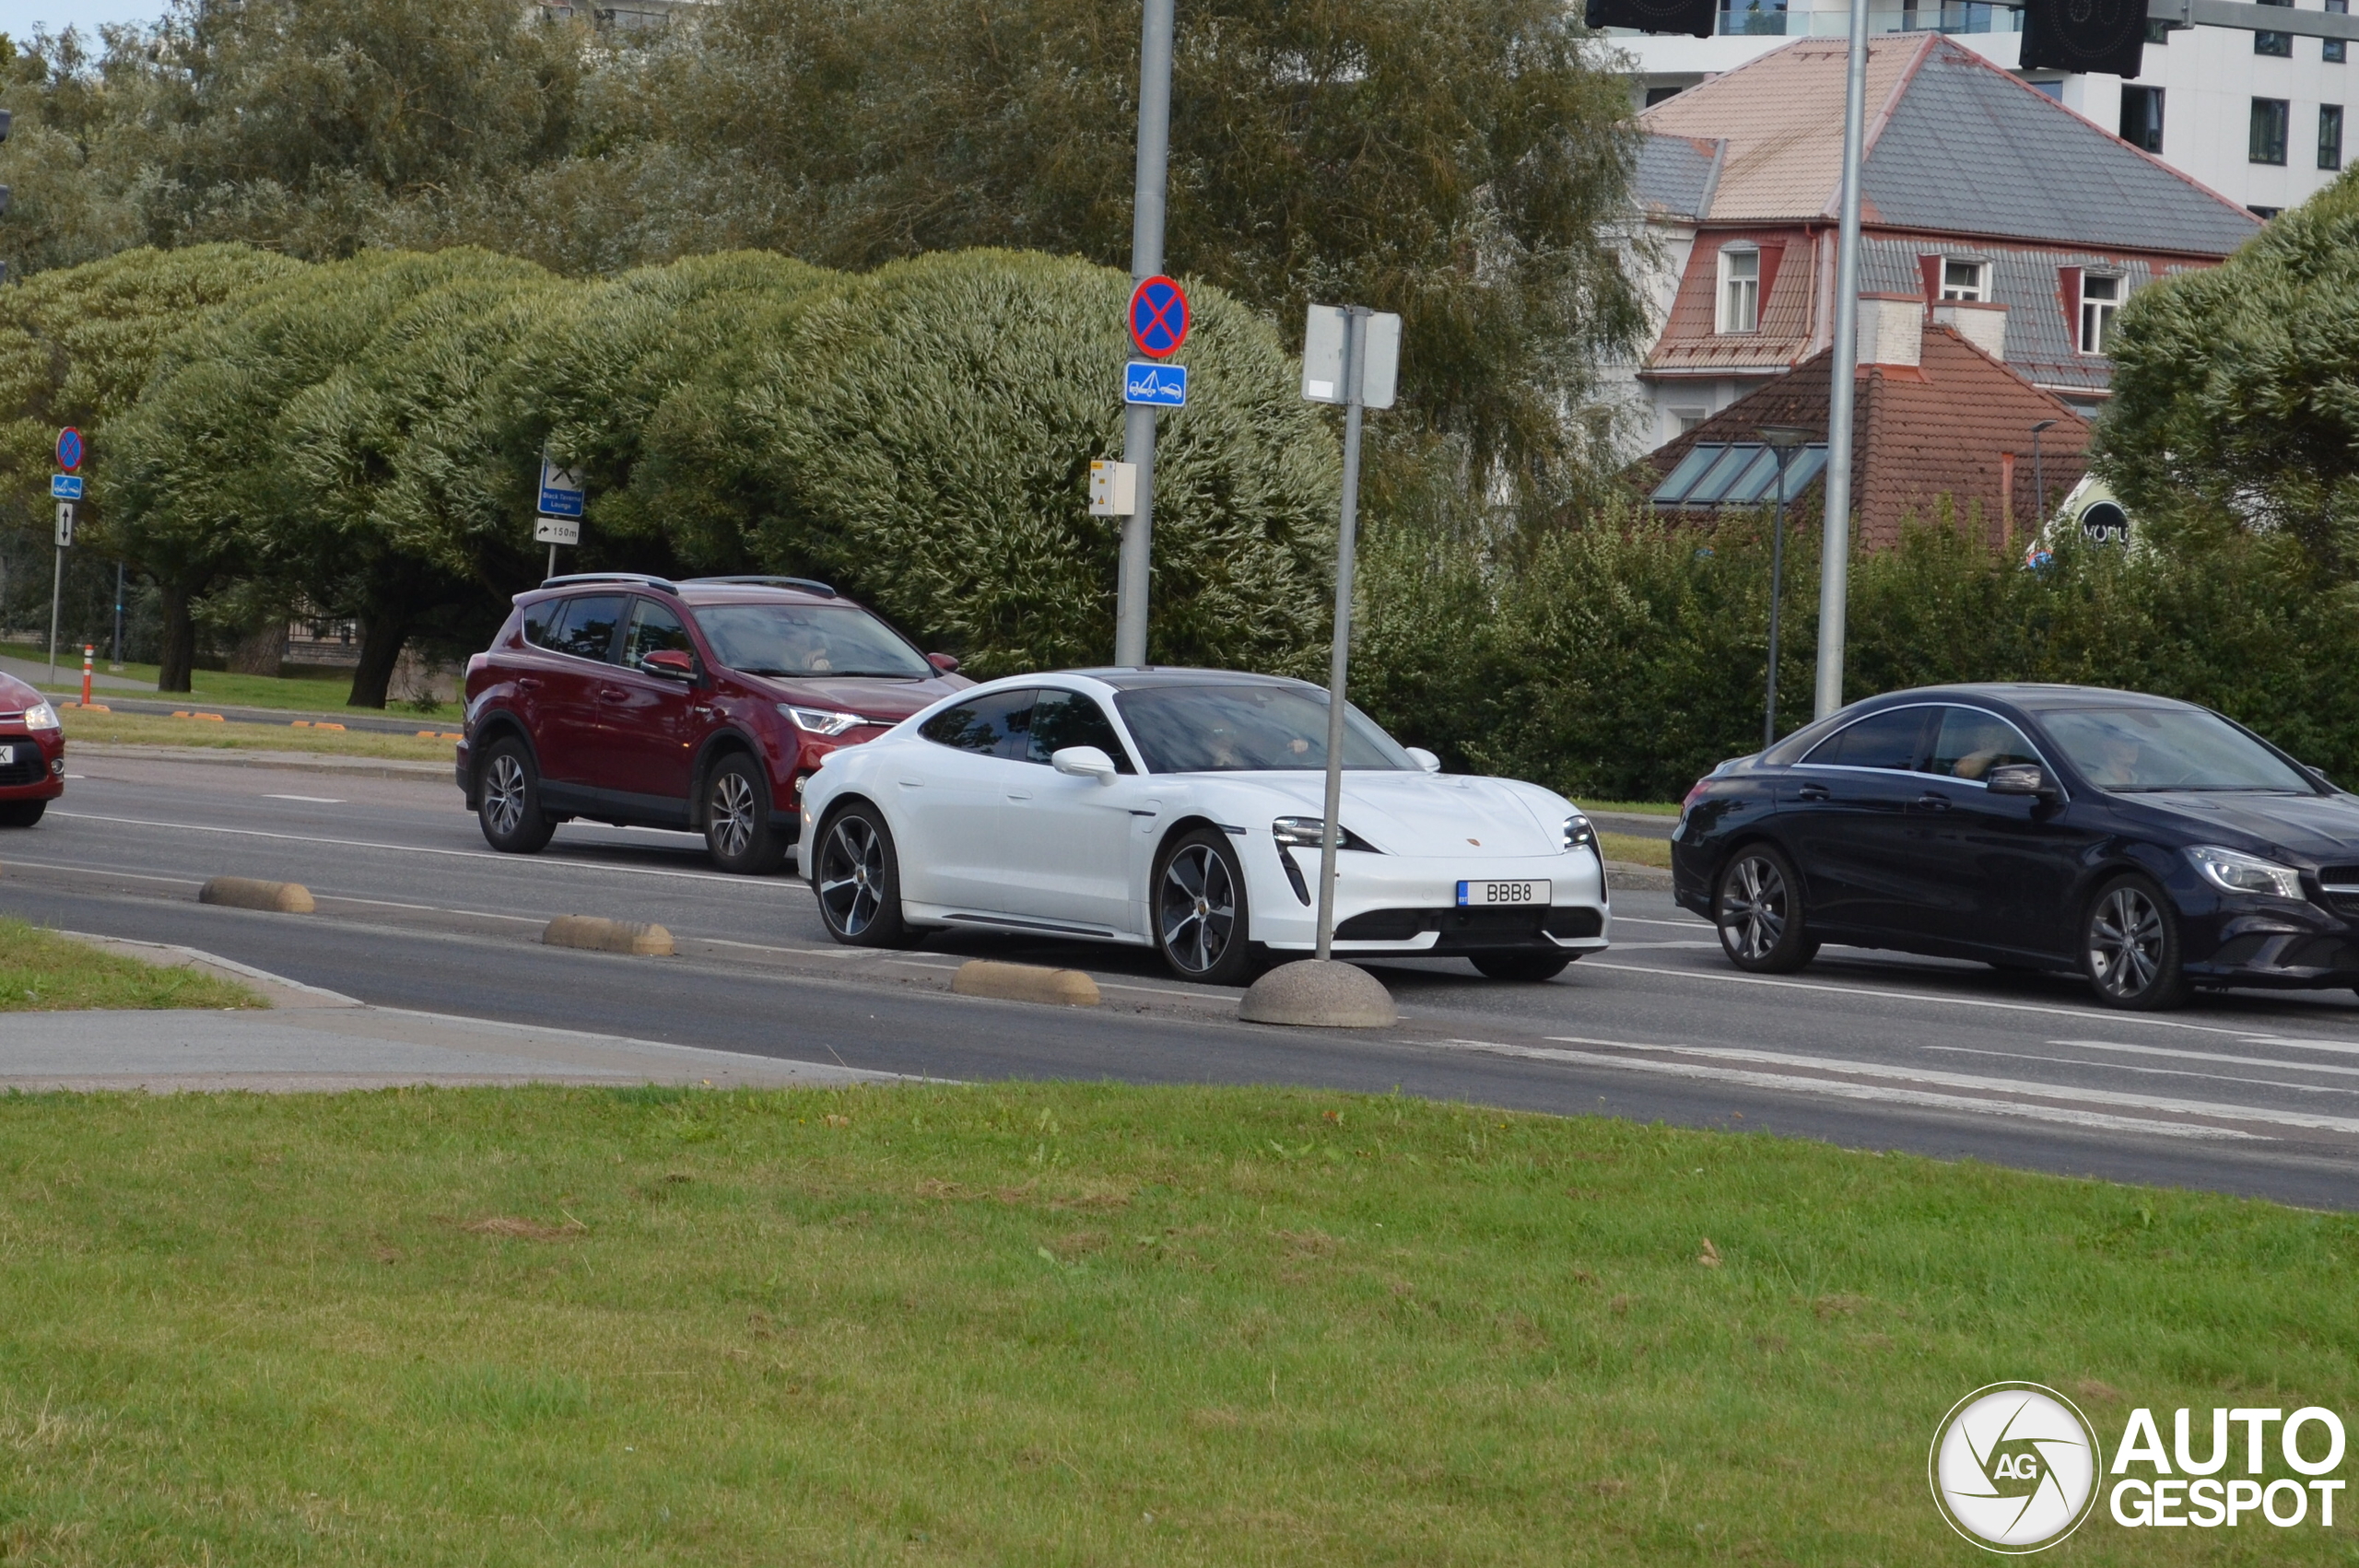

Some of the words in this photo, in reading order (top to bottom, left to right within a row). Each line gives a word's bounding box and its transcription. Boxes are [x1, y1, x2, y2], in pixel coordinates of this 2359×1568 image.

[550, 501, 571, 510] Lounge
[553, 527, 577, 538] 150m
[1486, 883, 1532, 902] BBB8
